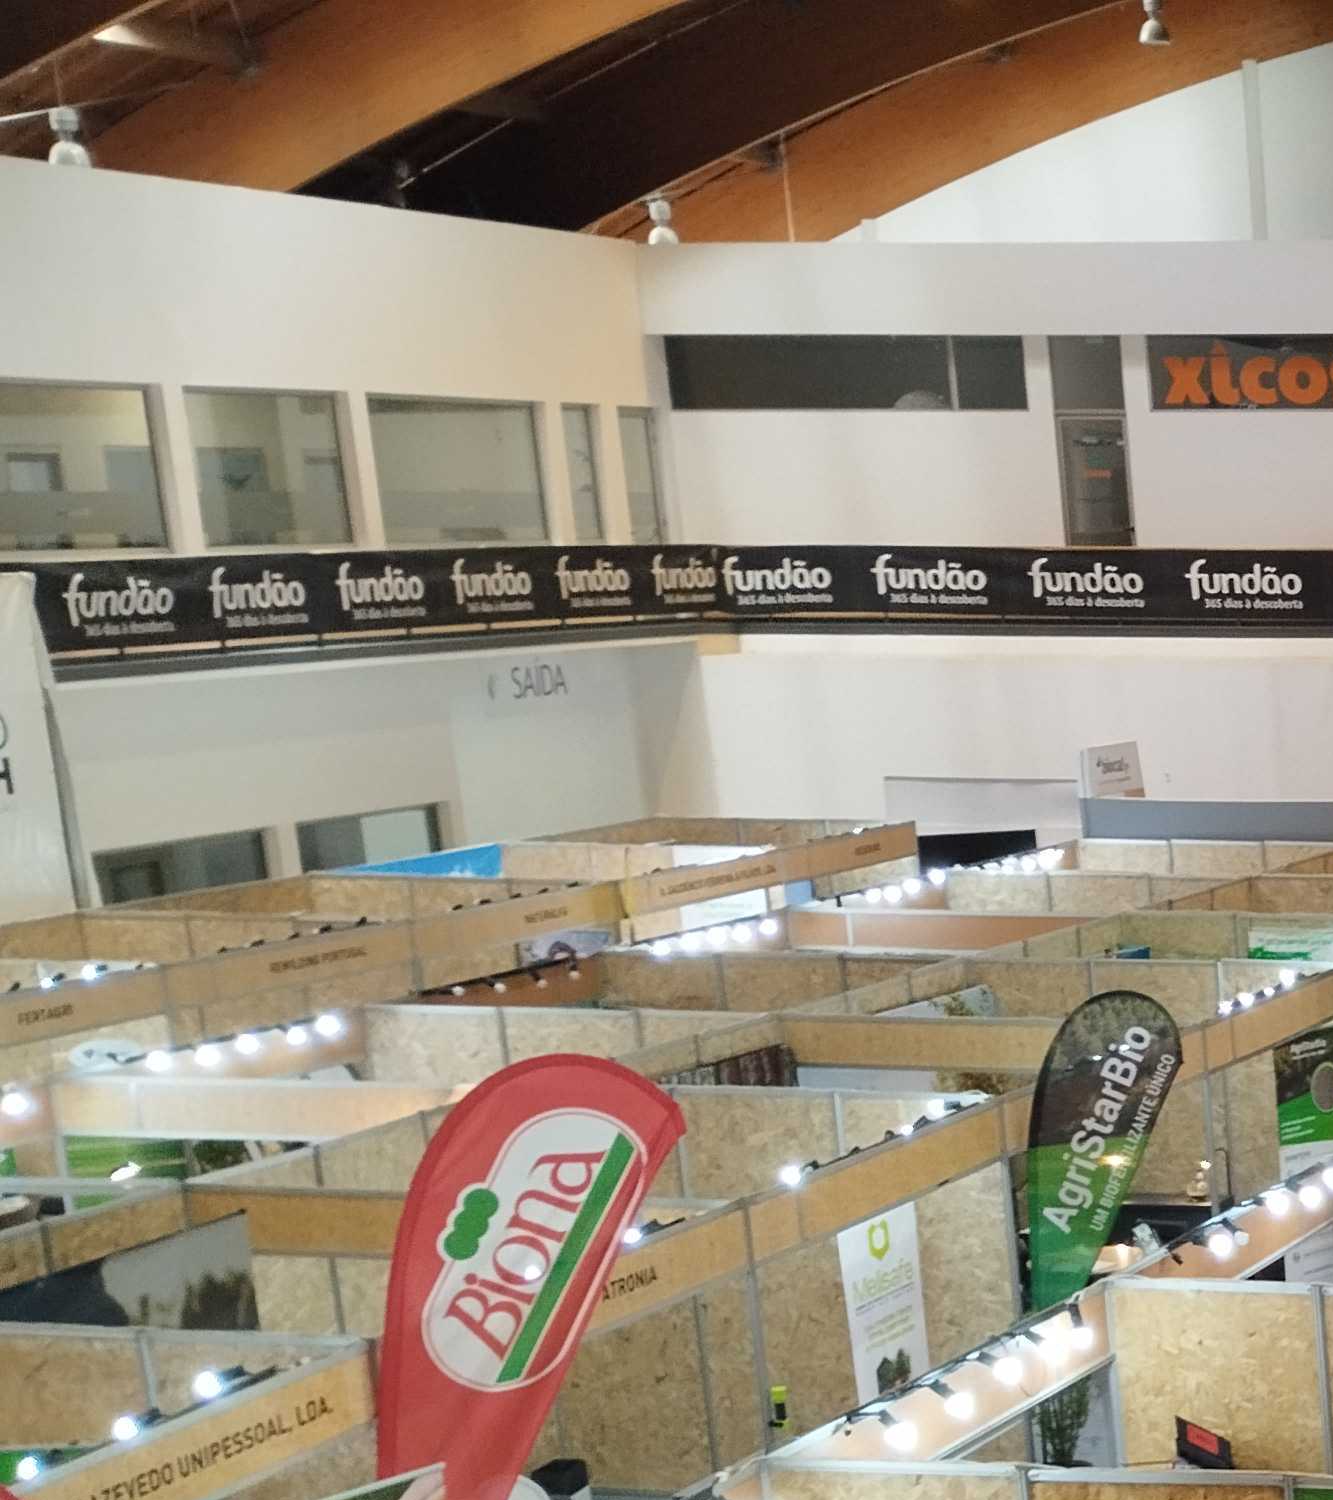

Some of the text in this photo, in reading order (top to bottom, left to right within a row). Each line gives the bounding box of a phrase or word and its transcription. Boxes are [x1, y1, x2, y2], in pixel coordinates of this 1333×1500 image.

[209, 566, 305, 618] fundão
[336, 561, 424, 611] fundão
[451, 558, 532, 605] fundão
[556, 555, 631, 600] fundão
[651, 553, 717, 597] fundão
[722, 556, 833, 598] fundão
[871, 554, 988, 596] fundão
[1027, 557, 1144, 598] fundão
[1185, 558, 1303, 600] fundão
[63, 572, 174, 627] fundão
[510, 658, 568, 699] SAÍDA
[1042, 1024, 1153, 1235] AgriStarBio
[443, 1149, 607, 1362] Biona
